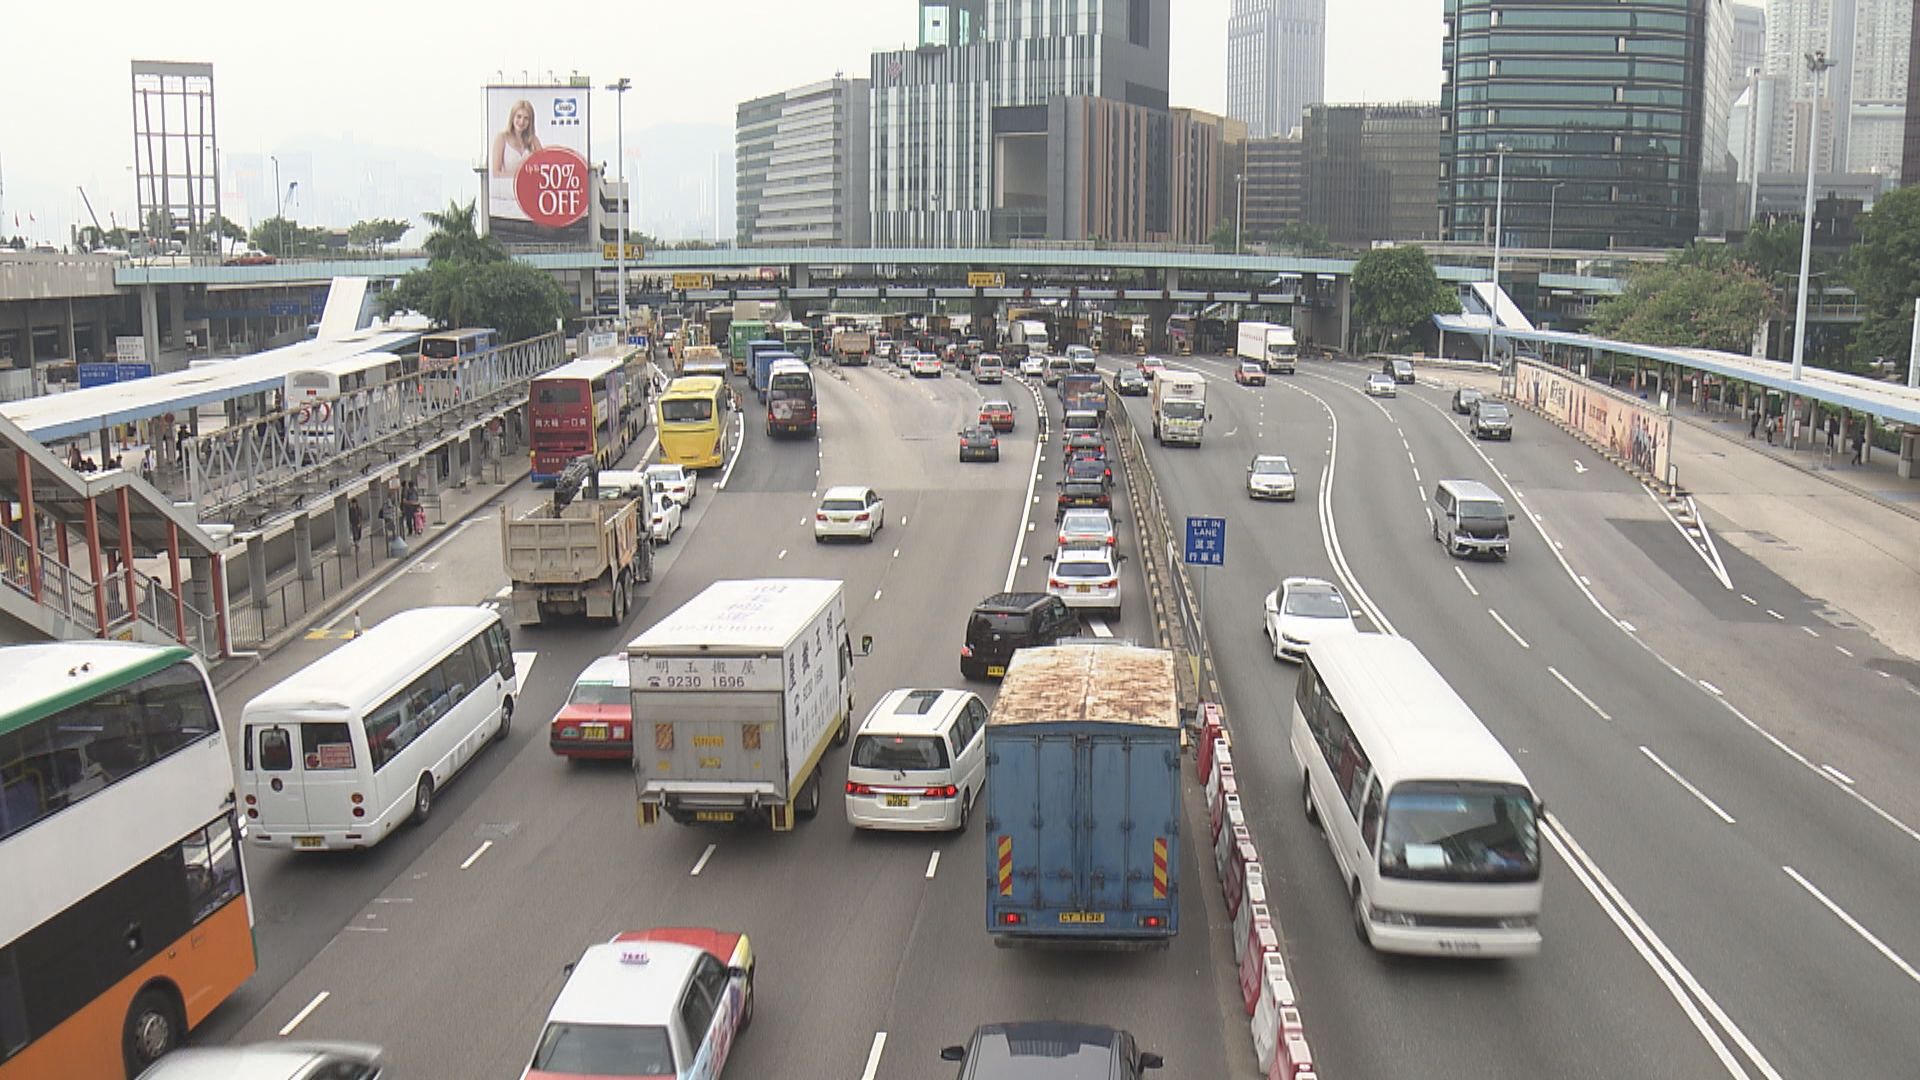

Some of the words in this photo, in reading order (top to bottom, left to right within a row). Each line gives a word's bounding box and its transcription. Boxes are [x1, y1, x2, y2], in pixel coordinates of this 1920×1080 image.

[539, 164, 580, 190] 50%
[538, 190, 580, 216] OFF
[633, 246, 641, 257] A
[703, 275, 710, 287] A
[995, 273, 1002, 285] A
[1191, 520, 1208, 528] GET
[1211, 520, 1221, 528] IN
[1194, 528, 1217, 537] LANE
[667, 676, 701, 688] 9230
[712, 675, 745, 688] 1696
